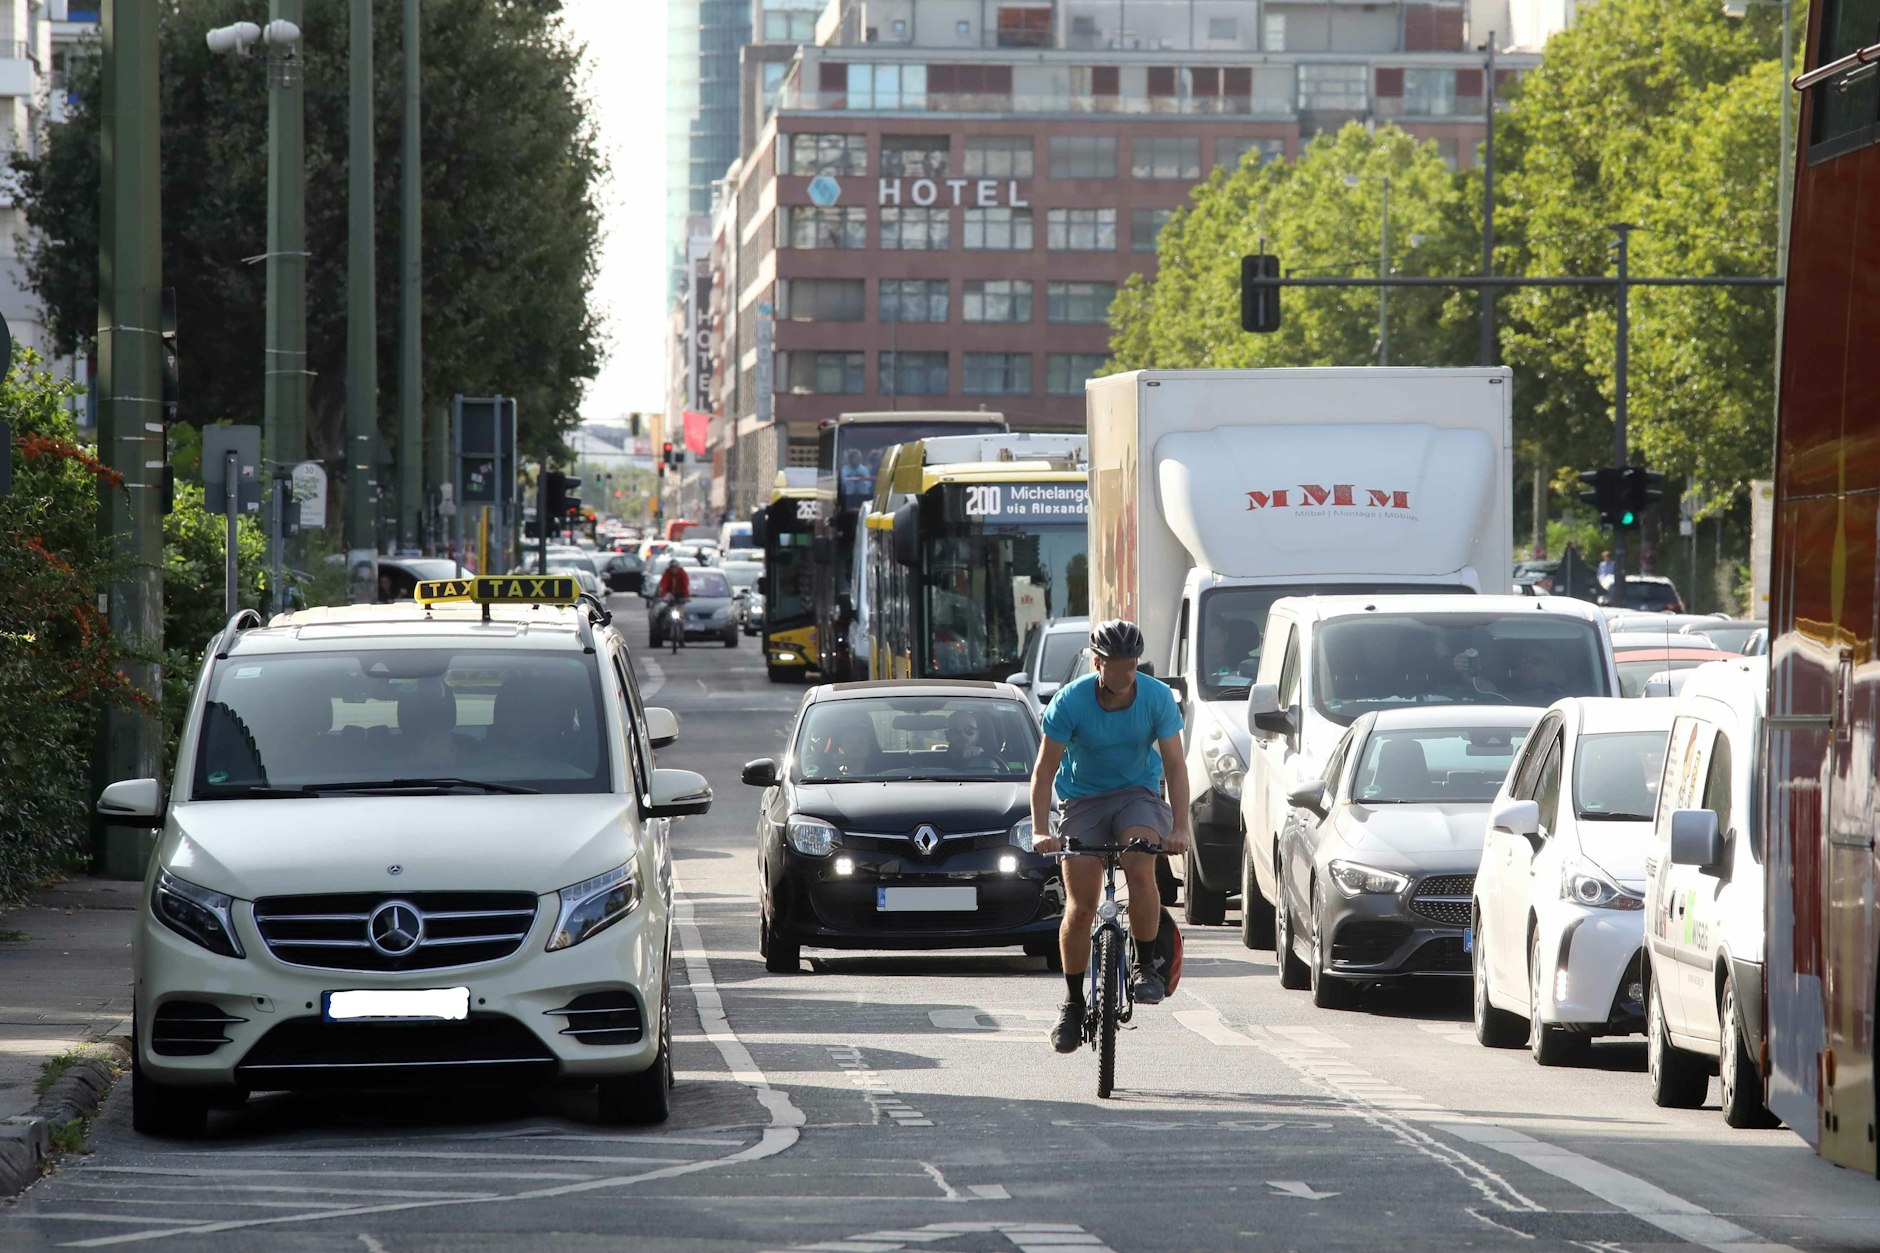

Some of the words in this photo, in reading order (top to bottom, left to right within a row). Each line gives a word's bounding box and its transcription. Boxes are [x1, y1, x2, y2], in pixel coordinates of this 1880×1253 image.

[879, 178, 1029, 207] HOTEL
[697, 308, 712, 412] HOTEL
[966, 486, 1001, 515] 200
[1007, 503, 1026, 514] via
[489, 580, 560, 597] TAXI
